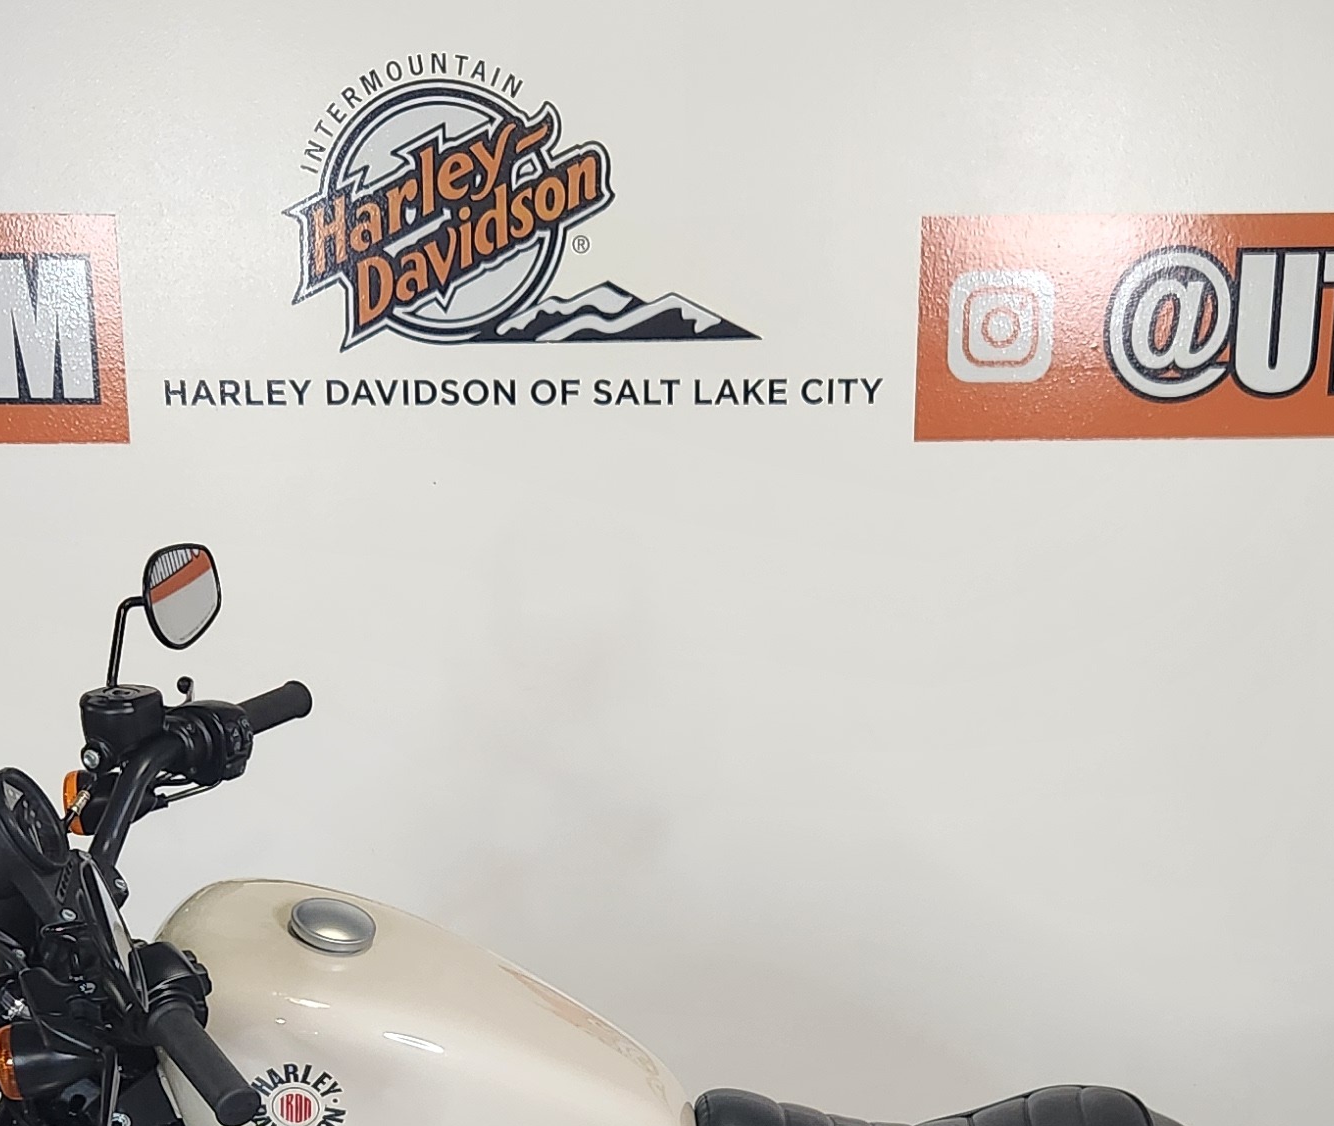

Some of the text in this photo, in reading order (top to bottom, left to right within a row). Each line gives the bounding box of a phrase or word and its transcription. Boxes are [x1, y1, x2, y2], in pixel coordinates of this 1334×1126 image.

[300, 52, 523, 174] INTERMOUNTAIN
[355, 155, 598, 326] Davidson
[164, 378, 883, 406] HARLEY DAVIDSON OF SALT LAKE CITY
[251, 1063, 343, 1098] HARLEY
[279, 1093, 312, 1124] IRON
